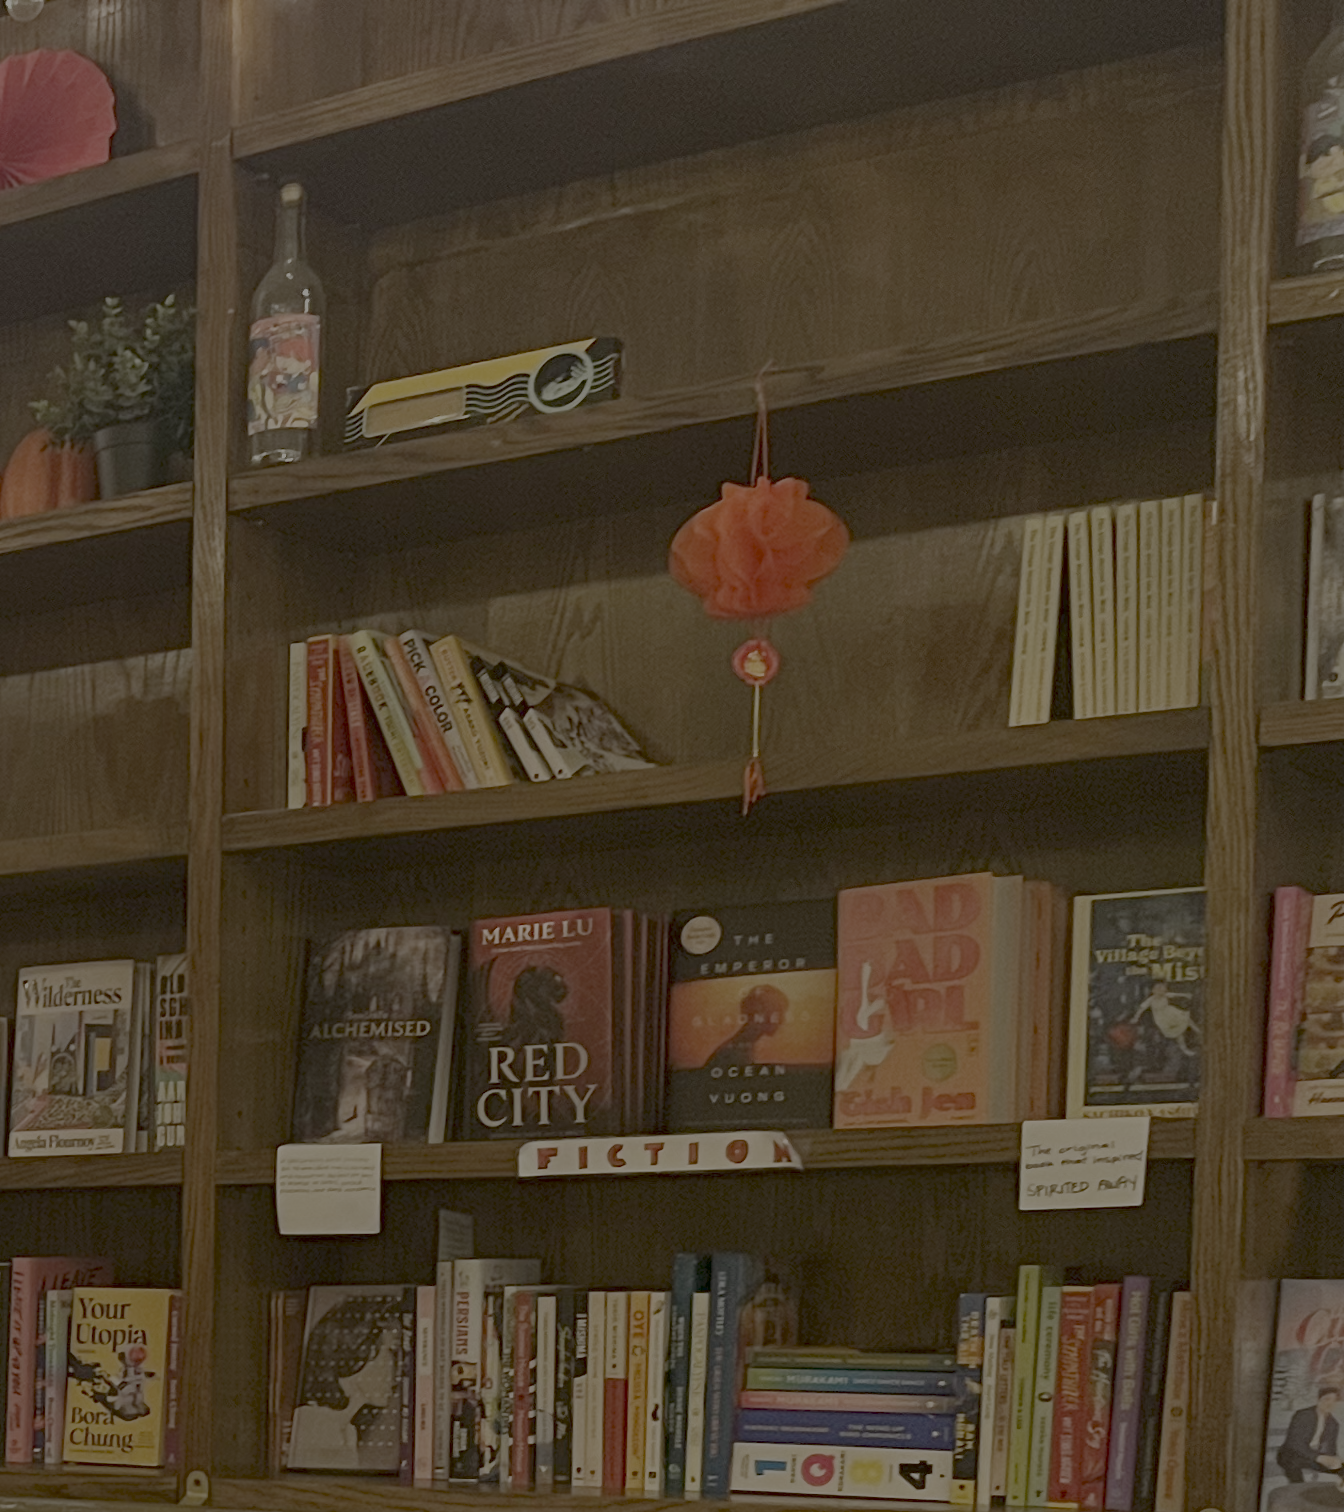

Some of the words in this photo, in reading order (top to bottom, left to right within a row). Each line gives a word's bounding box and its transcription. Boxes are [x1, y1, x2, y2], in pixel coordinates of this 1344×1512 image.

[404, 639, 425, 674] PICK
[425, 685, 452, 735] COLOR
[481, 921, 556, 946] MARIE
[562, 918, 594, 940] LU
[733, 932, 775, 947] THE
[1126, 934, 1159, 948] The
[699, 957, 807, 975] EMPEROR
[1096, 948, 1159, 964] Village
[22, 979, 123, 1009] Wilderness
[309, 1019, 431, 1040] ALCHEMISED
[488, 1042, 590, 1086] RED
[711, 1064, 787, 1080] OCEAN
[476, 1084, 598, 1128] CITY
[708, 1090, 786, 1105] VUONG
[921, 1087, 976, 1113] Jen
[536, 1140, 796, 1170] FICTION
[1025, 1145, 1051, 1156] The
[1058, 1141, 1115, 1156] original
[1027, 1181, 1090, 1196] SPIRITED
[79, 1297, 131, 1320] Your
[1043, 1300, 1055, 1321] life
[1130, 1292, 1142, 1313] Hot
[455, 1291, 470, 1356] PERSIANS
[632, 1311, 645, 1338] OYE
[1127, 1317, 1140, 1344] Girls
[76, 1323, 147, 1353] Utopia
[1039, 1327, 1052, 1380] ceremony
[1124, 1348, 1138, 1374] with
[1121, 1378, 1135, 1411] Balls
[70, 1407, 114, 1426] Bora
[69, 1428, 134, 1453] Chung
